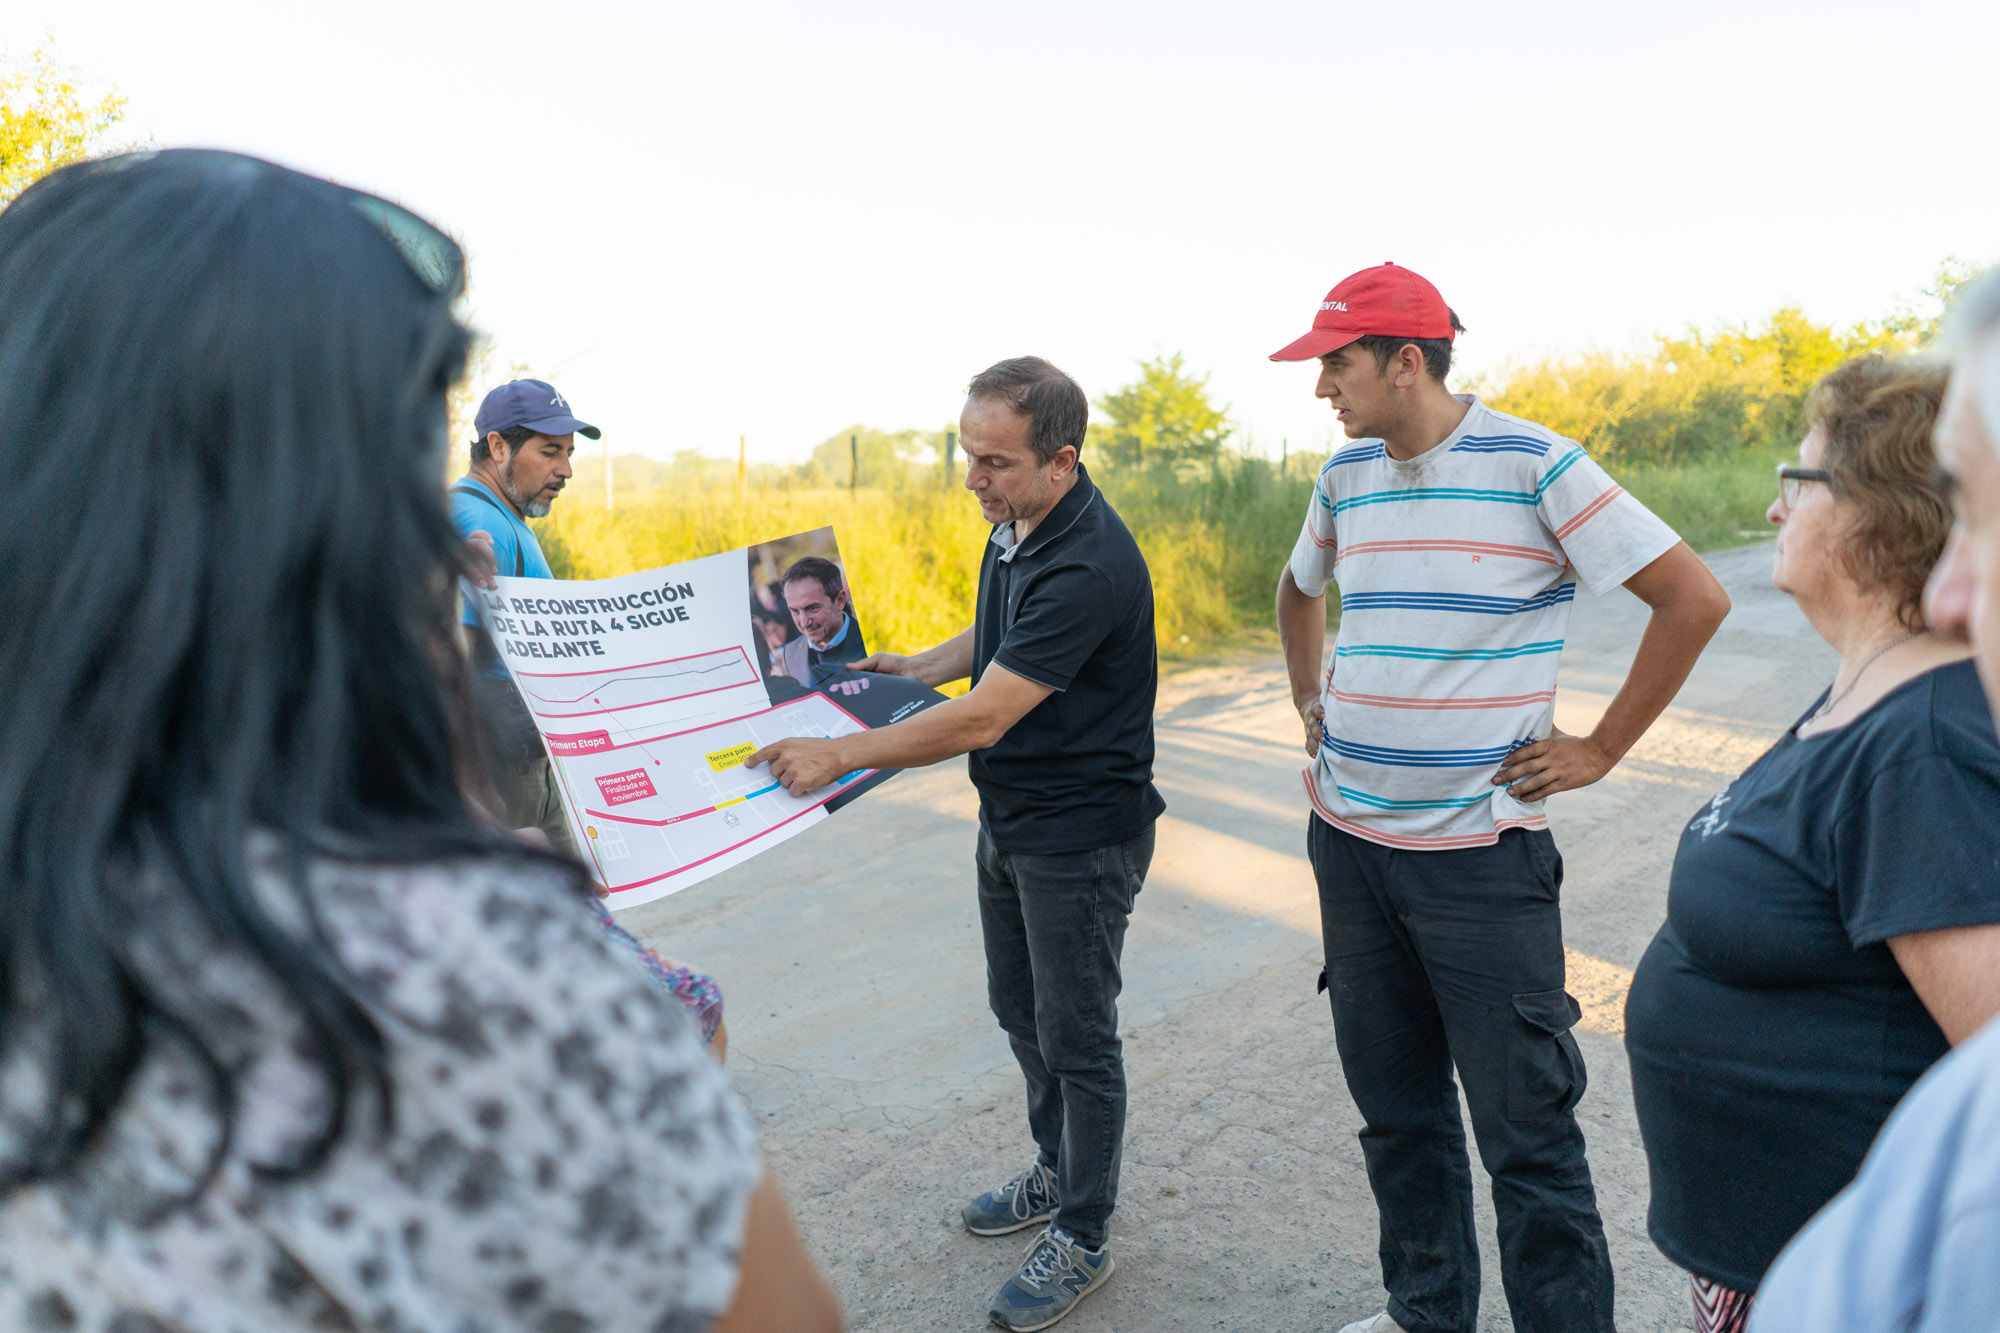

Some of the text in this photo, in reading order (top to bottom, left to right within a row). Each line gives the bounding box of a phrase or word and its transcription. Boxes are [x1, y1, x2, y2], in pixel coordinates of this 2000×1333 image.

[1472, 555, 1481, 563] R
[510, 582, 695, 615] RECONSTRUCCIÓN
[492, 605, 690, 636] DE LA RUTA 4 SIGUE
[504, 638, 606, 658] ADELANTE
[549, 737, 605, 750] Primera Etapa
[709, 746, 752, 762] Tercera parte
[718, 759, 738, 768] Enero
[598, 772, 645, 787] Primera parte
[605, 782, 638, 794] Finalizada
[612, 789, 648, 802] noviembre
